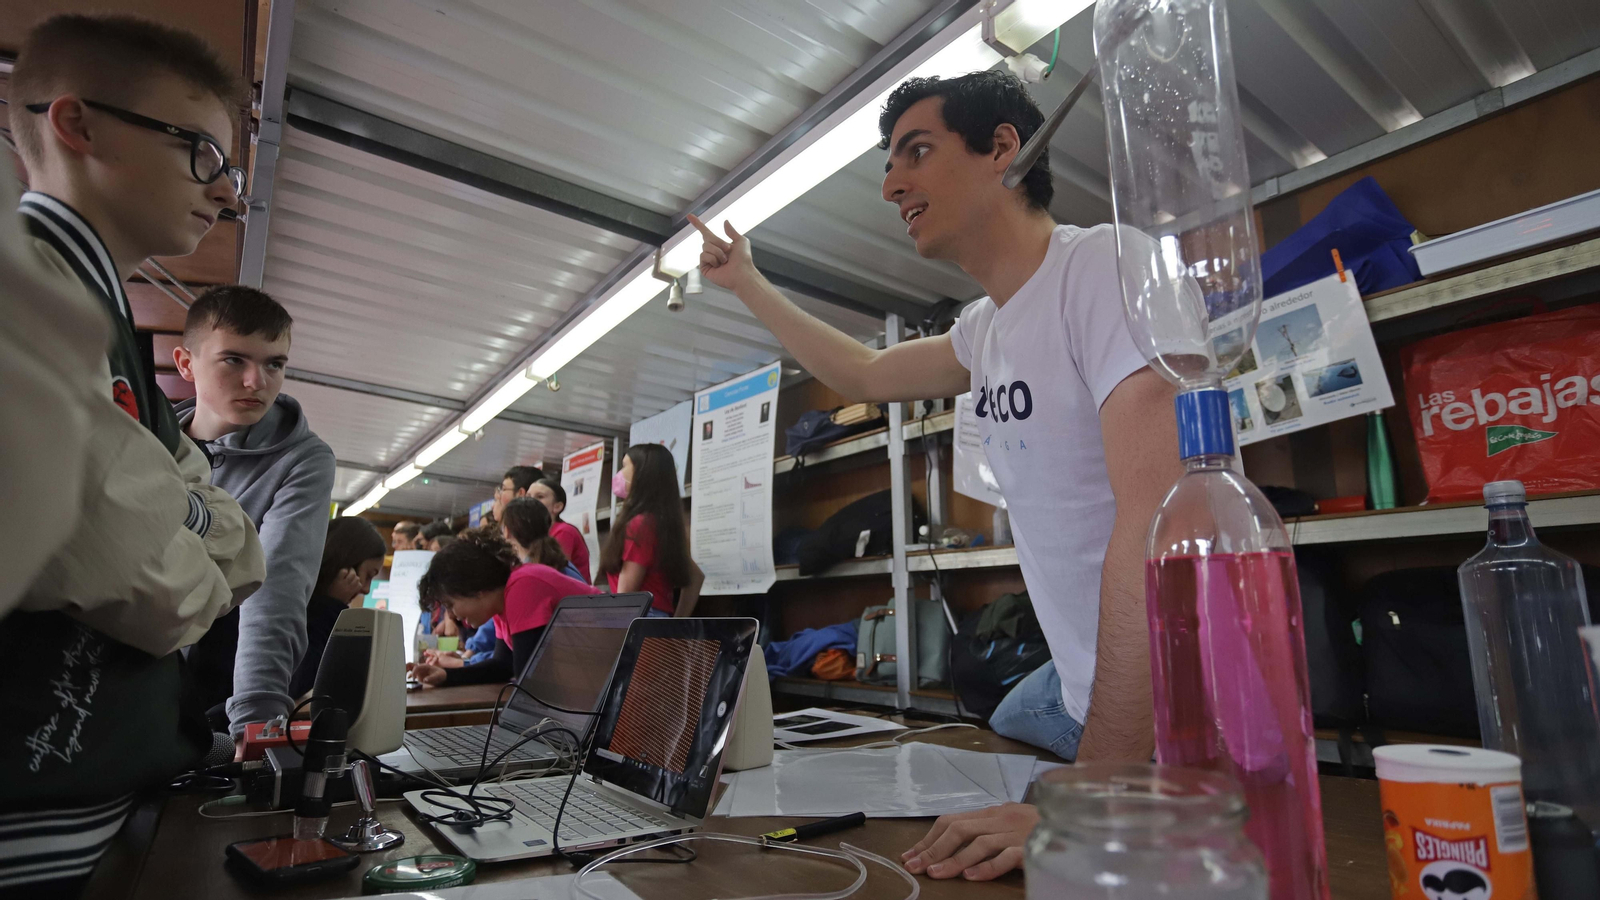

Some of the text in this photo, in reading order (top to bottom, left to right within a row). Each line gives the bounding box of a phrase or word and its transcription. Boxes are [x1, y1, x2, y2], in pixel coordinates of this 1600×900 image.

[1269, 290, 1314, 313] alrededor
[1418, 390, 1456, 409] Las
[25, 713, 60, 772] culture
[1424, 818, 1471, 831] PAPRIKA
[1414, 831, 1488, 868] PRINGLES
